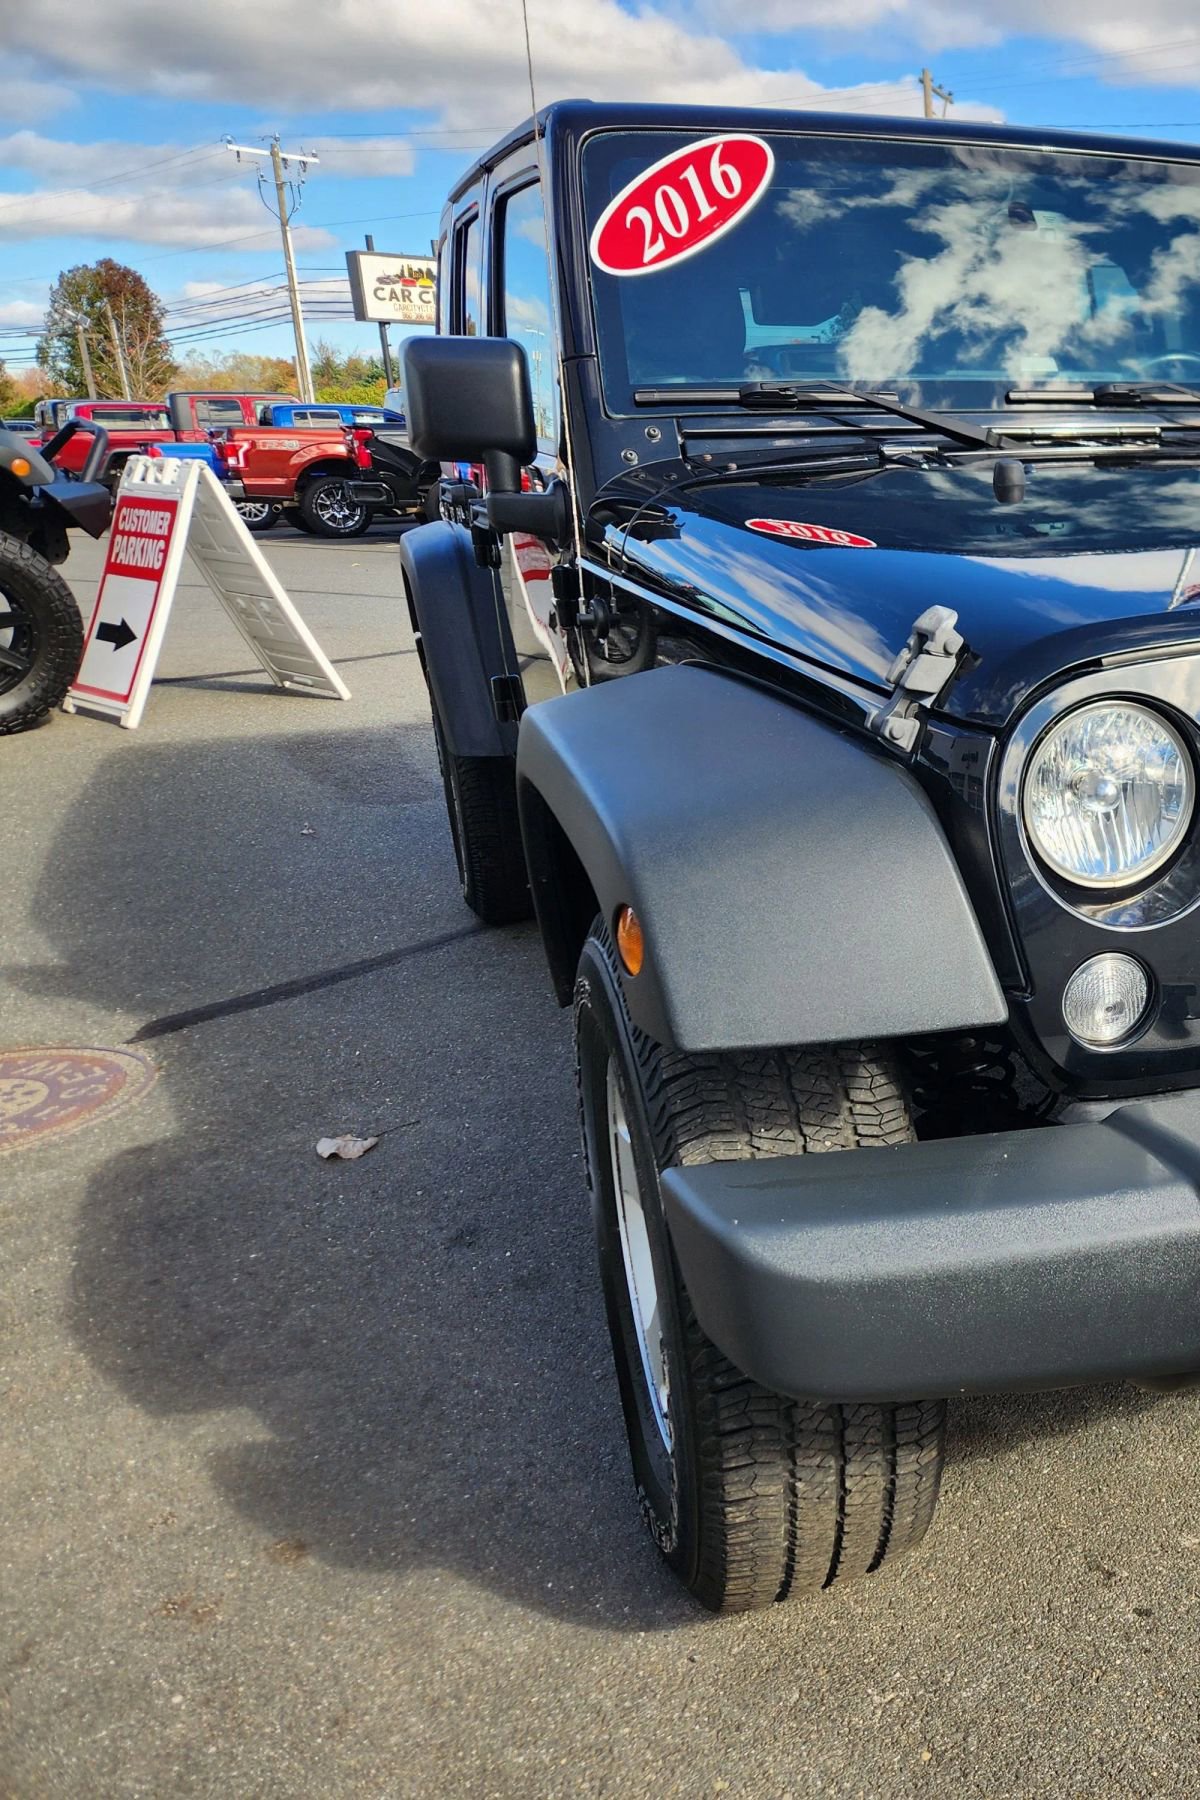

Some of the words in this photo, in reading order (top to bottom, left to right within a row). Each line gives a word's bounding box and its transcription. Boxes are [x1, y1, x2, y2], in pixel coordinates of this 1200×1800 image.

[625, 143, 742, 264] 2016
[373, 286, 413, 304] CAR
[118, 506, 171, 536] CUSTOMER
[111, 535, 165, 570] PARKING
